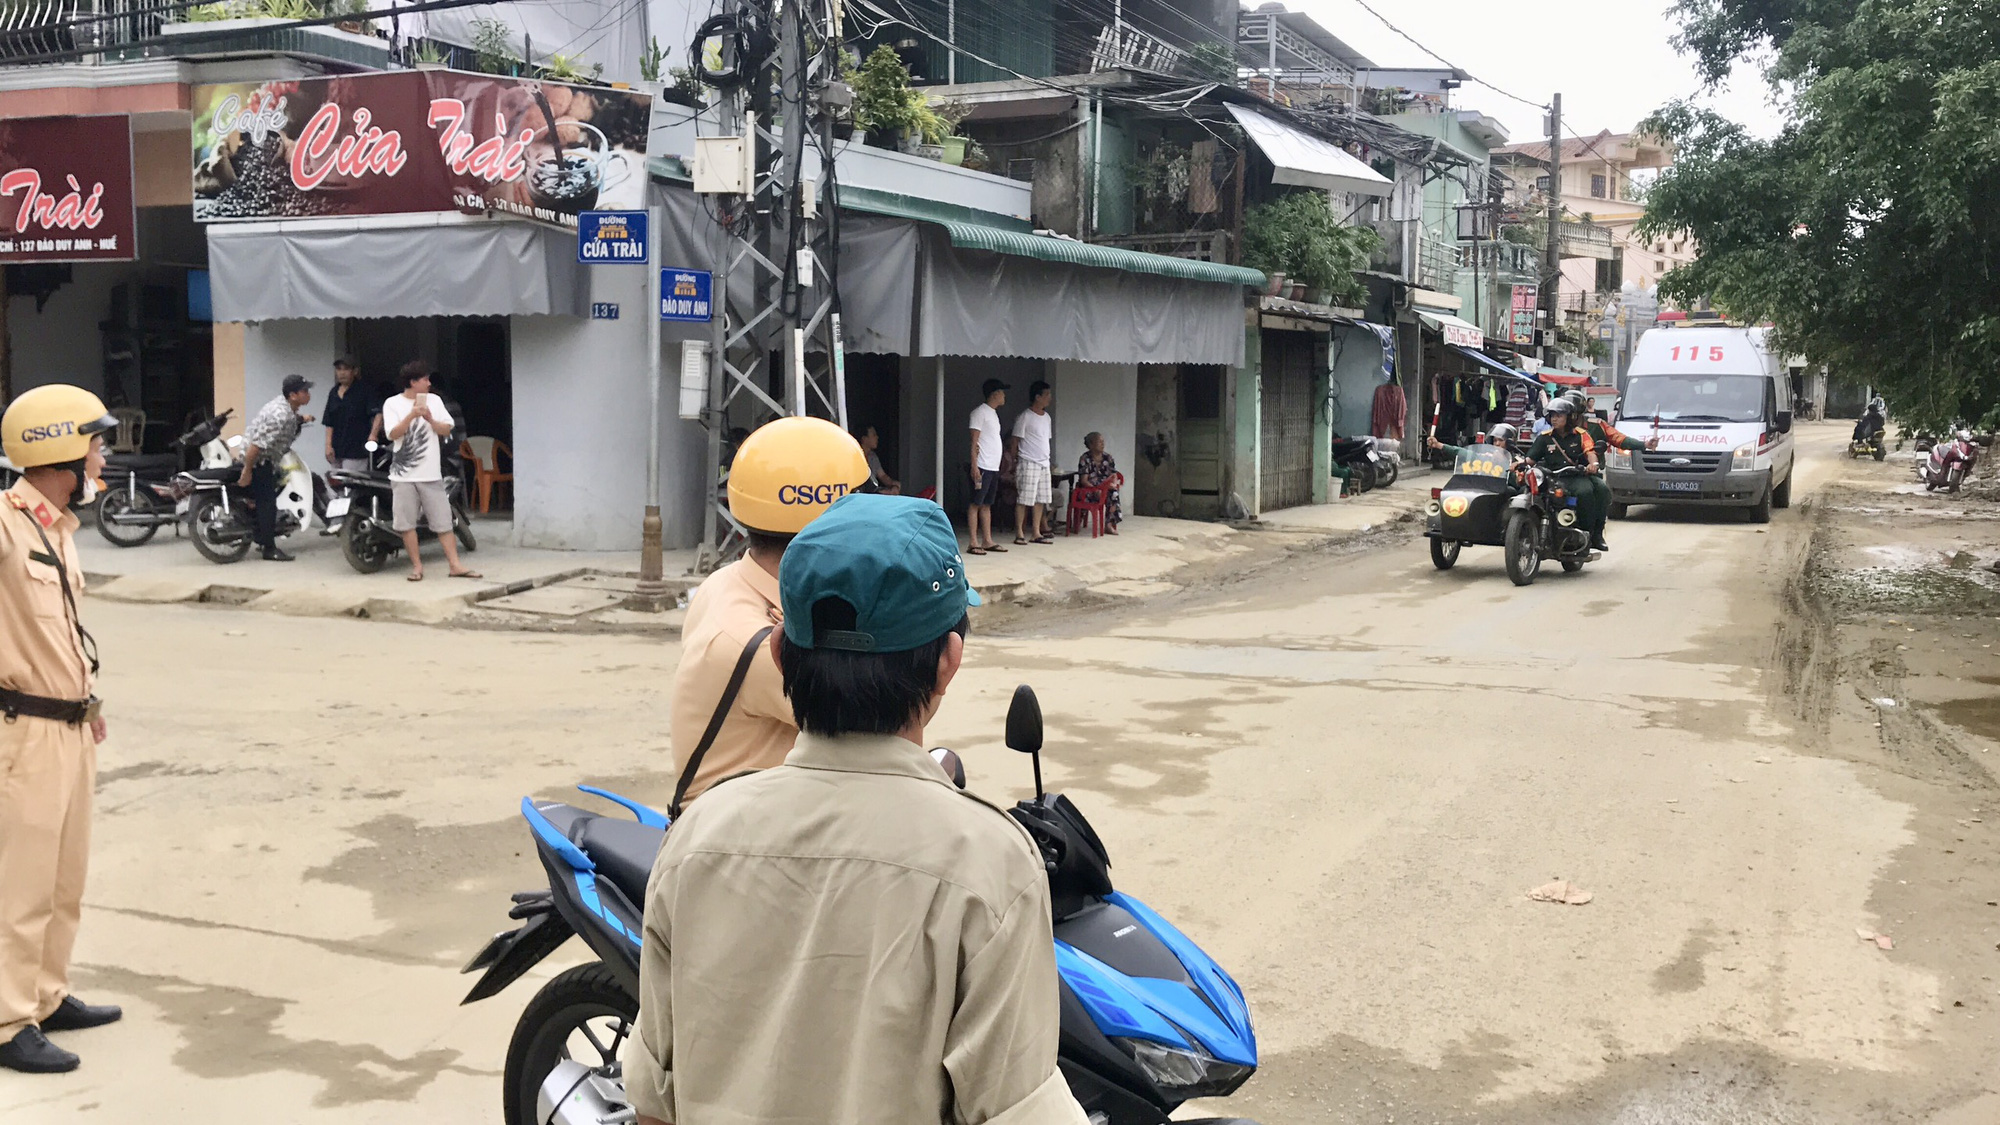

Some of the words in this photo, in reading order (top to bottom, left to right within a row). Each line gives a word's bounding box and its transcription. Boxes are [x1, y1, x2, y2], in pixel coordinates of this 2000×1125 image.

[212, 93, 288, 146] Café
[290, 102, 407, 191] Cửa
[427, 98, 535, 182] Trài
[0, 168, 104, 233] Trài
[599, 215, 627, 225] ĐƯỜNG
[20, 240, 34, 251] 137
[55, 240, 72, 251] DUY
[74, 239, 92, 250] ANH
[99, 234, 117, 250] HUẾ
[583, 237, 609, 258] CỬA
[612, 239, 643, 258] TRÀI
[593, 304, 618, 317] 137
[662, 295, 677, 314] ĐÀO
[678, 300, 692, 315] DUY
[693, 301, 708, 316] ANH
[1670, 345, 1724, 361] 115
[21, 421, 74, 443] CSGT
[1461, 459, 1503, 477] KSQS
[778, 483, 849, 505] CSGT
